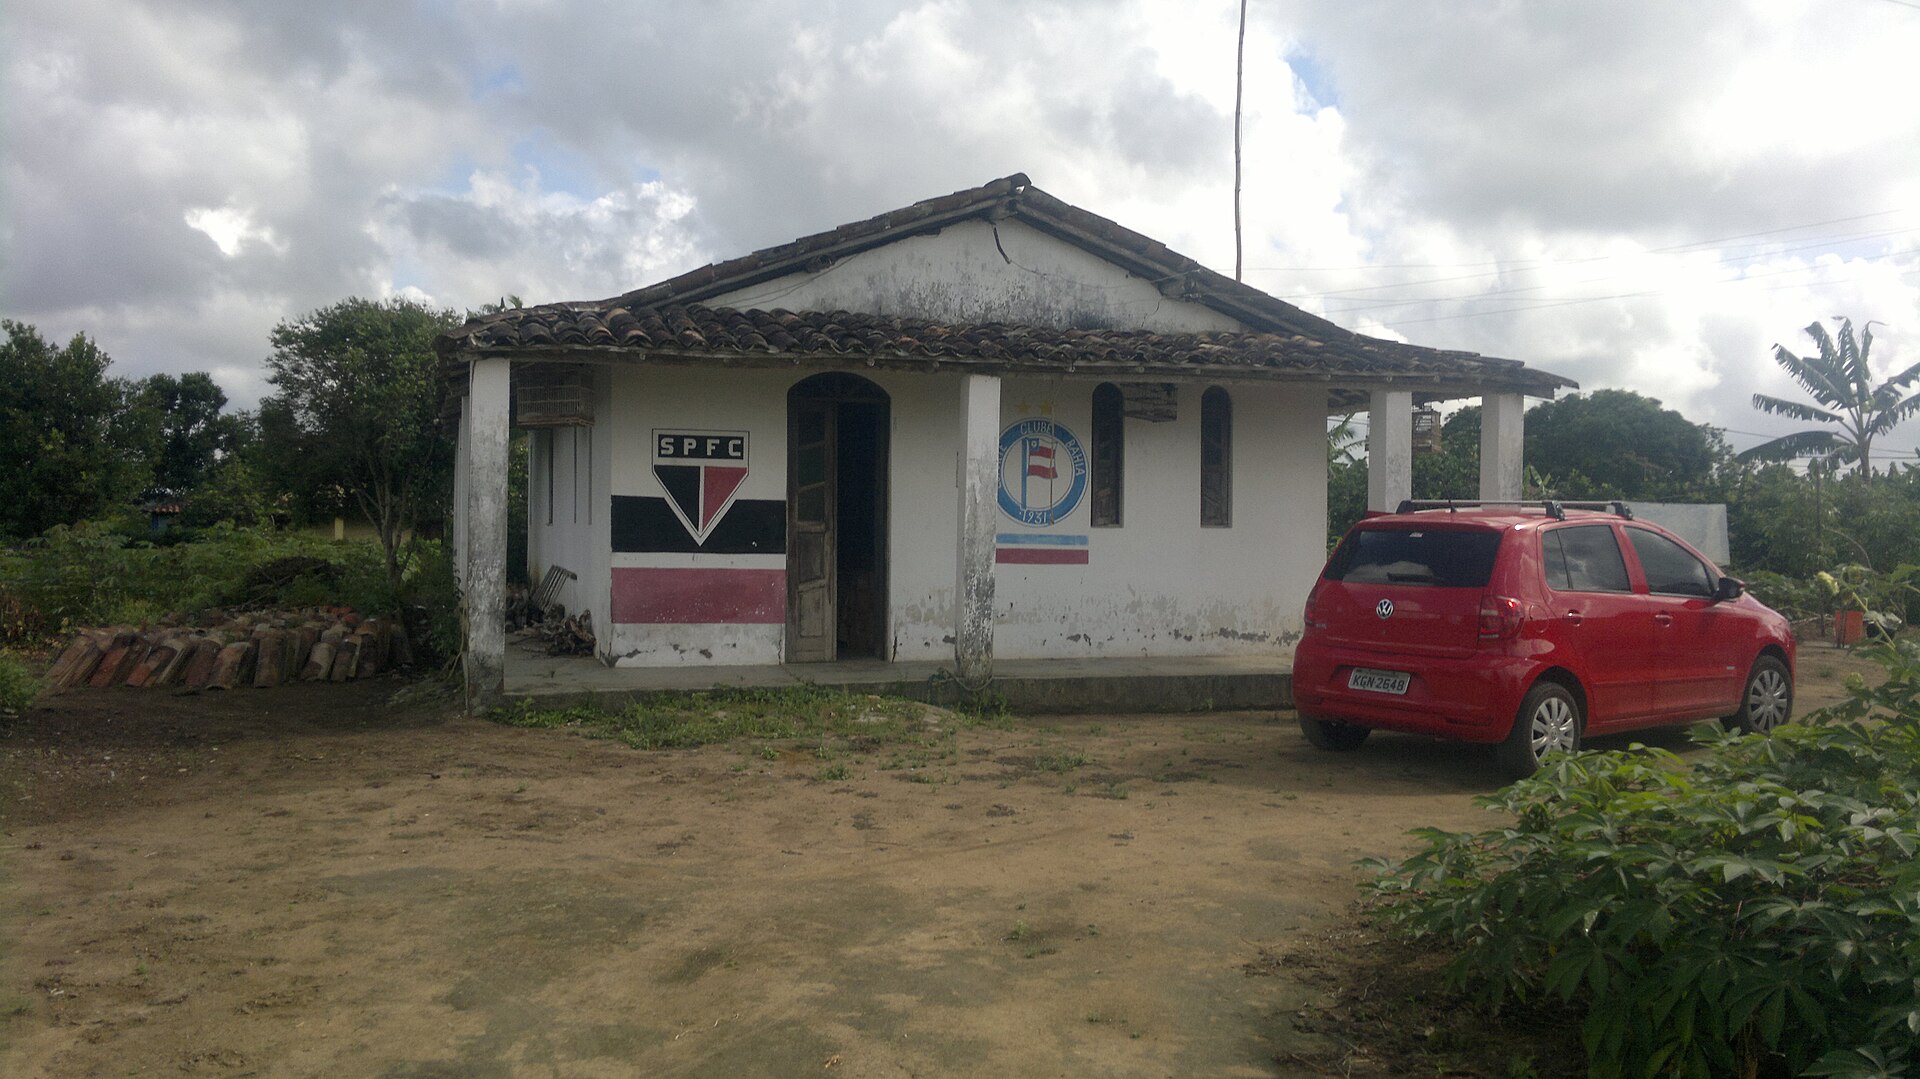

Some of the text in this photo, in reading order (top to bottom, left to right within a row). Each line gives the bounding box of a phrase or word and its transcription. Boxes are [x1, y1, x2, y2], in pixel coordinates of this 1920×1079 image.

[660, 437, 742, 457] SPFC
[1066, 439, 1085, 476] BAHIA
[1022, 510, 1047, 524] 1931
